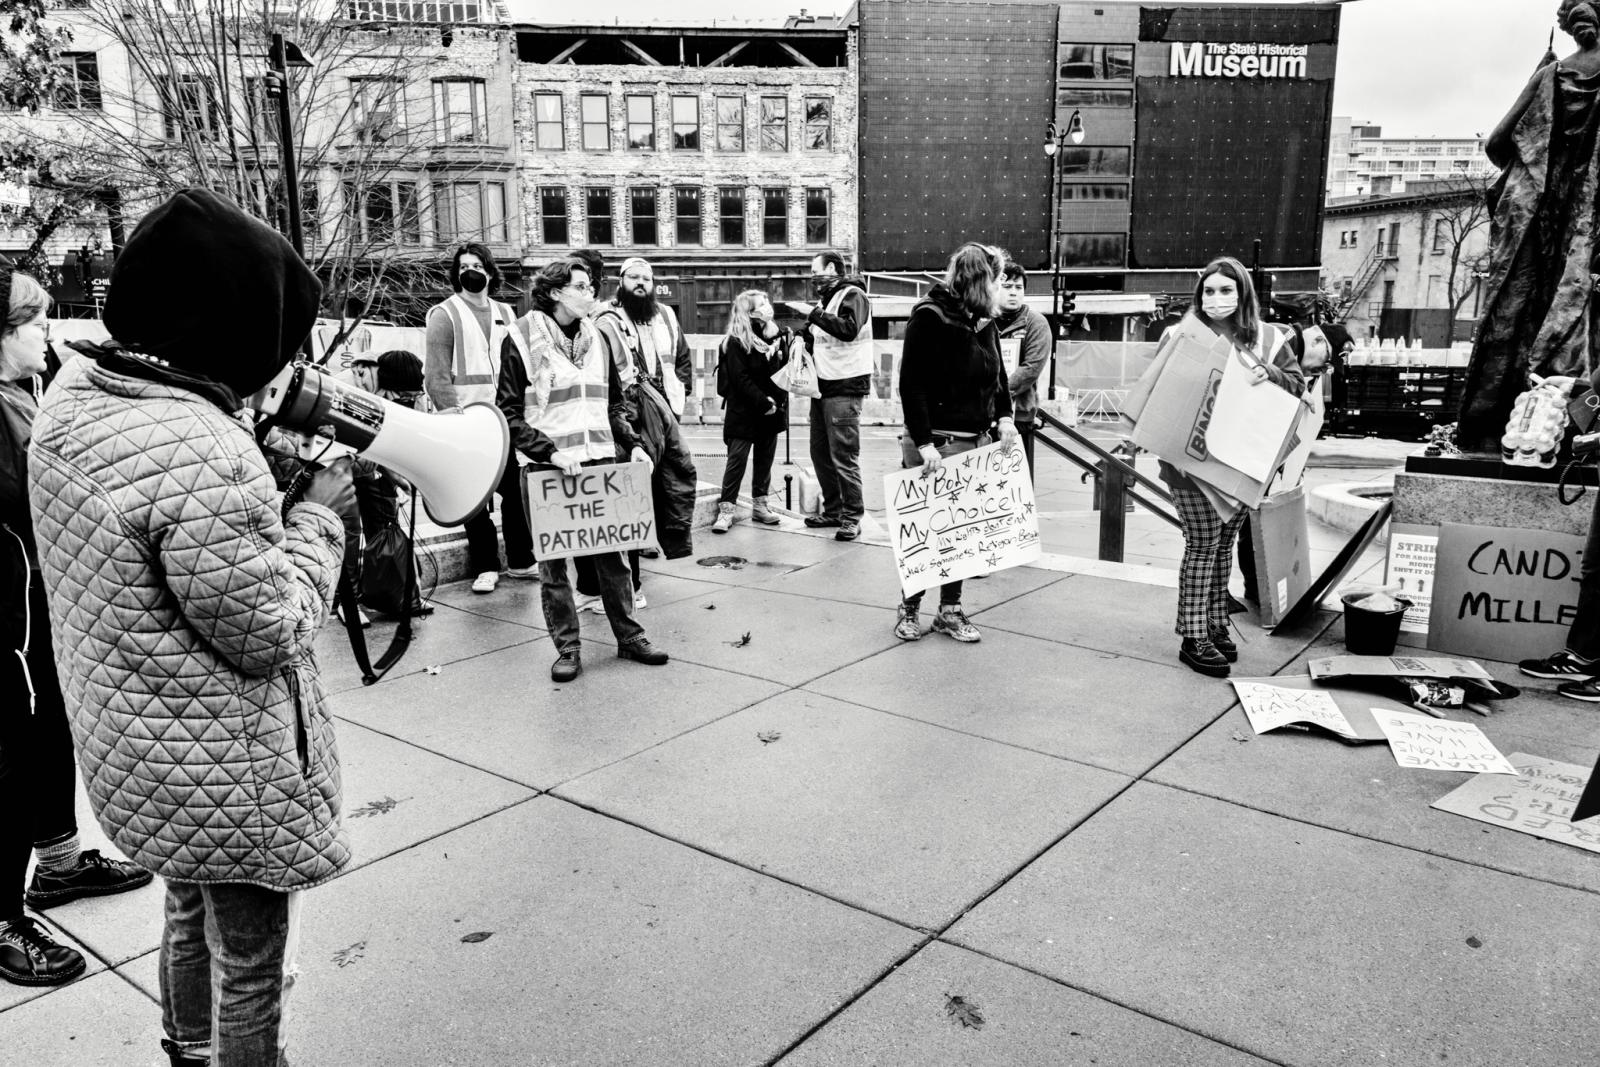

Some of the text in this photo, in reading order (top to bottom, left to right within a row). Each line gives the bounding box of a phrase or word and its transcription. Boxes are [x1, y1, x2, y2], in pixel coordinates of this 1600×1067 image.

[1170, 42, 1307, 78] Museum
[1206, 42, 1309, 56] The State Historical
[541, 470, 622, 501] FUCK
[893, 479, 929, 507] My
[934, 466, 973, 496] Body
[564, 499, 606, 521] THE
[538, 519, 653, 554] PATRIARCHY
[899, 521, 930, 549] My
